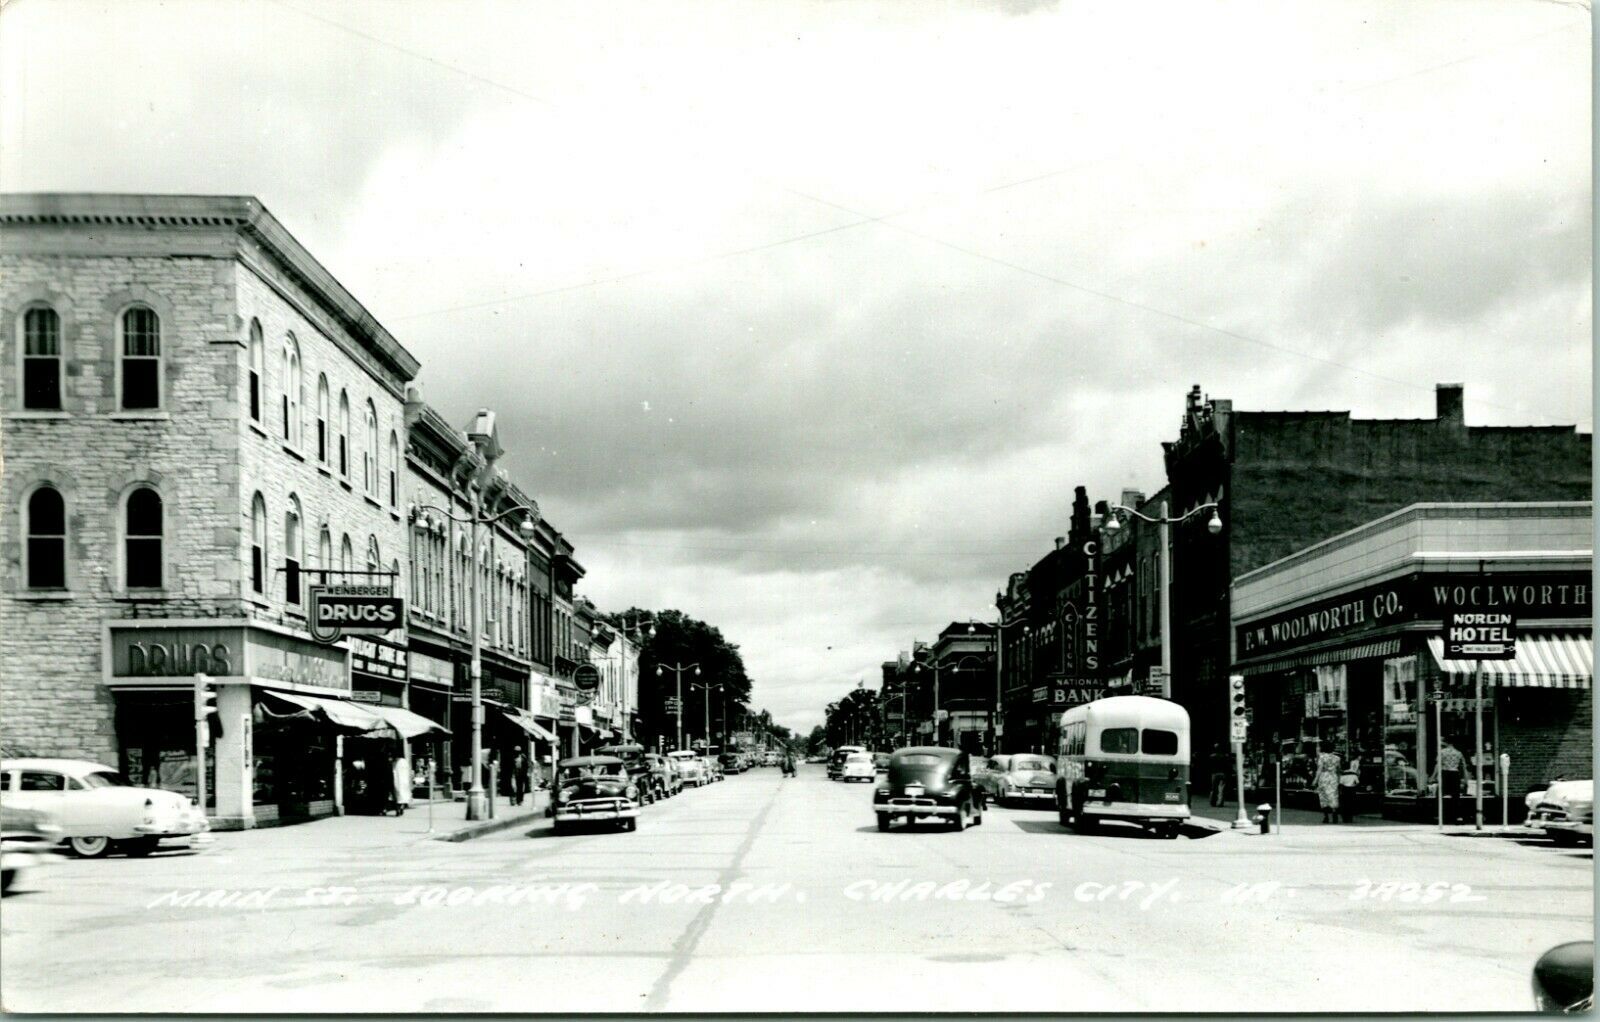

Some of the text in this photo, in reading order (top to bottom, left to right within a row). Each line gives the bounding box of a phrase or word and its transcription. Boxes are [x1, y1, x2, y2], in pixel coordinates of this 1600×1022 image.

[327, 586, 389, 596] WEINBERGER
[319, 603, 396, 622] DRUGS
[1083, 541, 1099, 670] CITIZENS
[1245, 591, 1403, 651] F. W. WOOLWORTH CO.
[1450, 627, 1514, 641] HOTEL
[128, 643, 232, 675] DRUGS
[1056, 678, 1104, 686] NATIONAL
[1054, 689, 1106, 703] BANK
